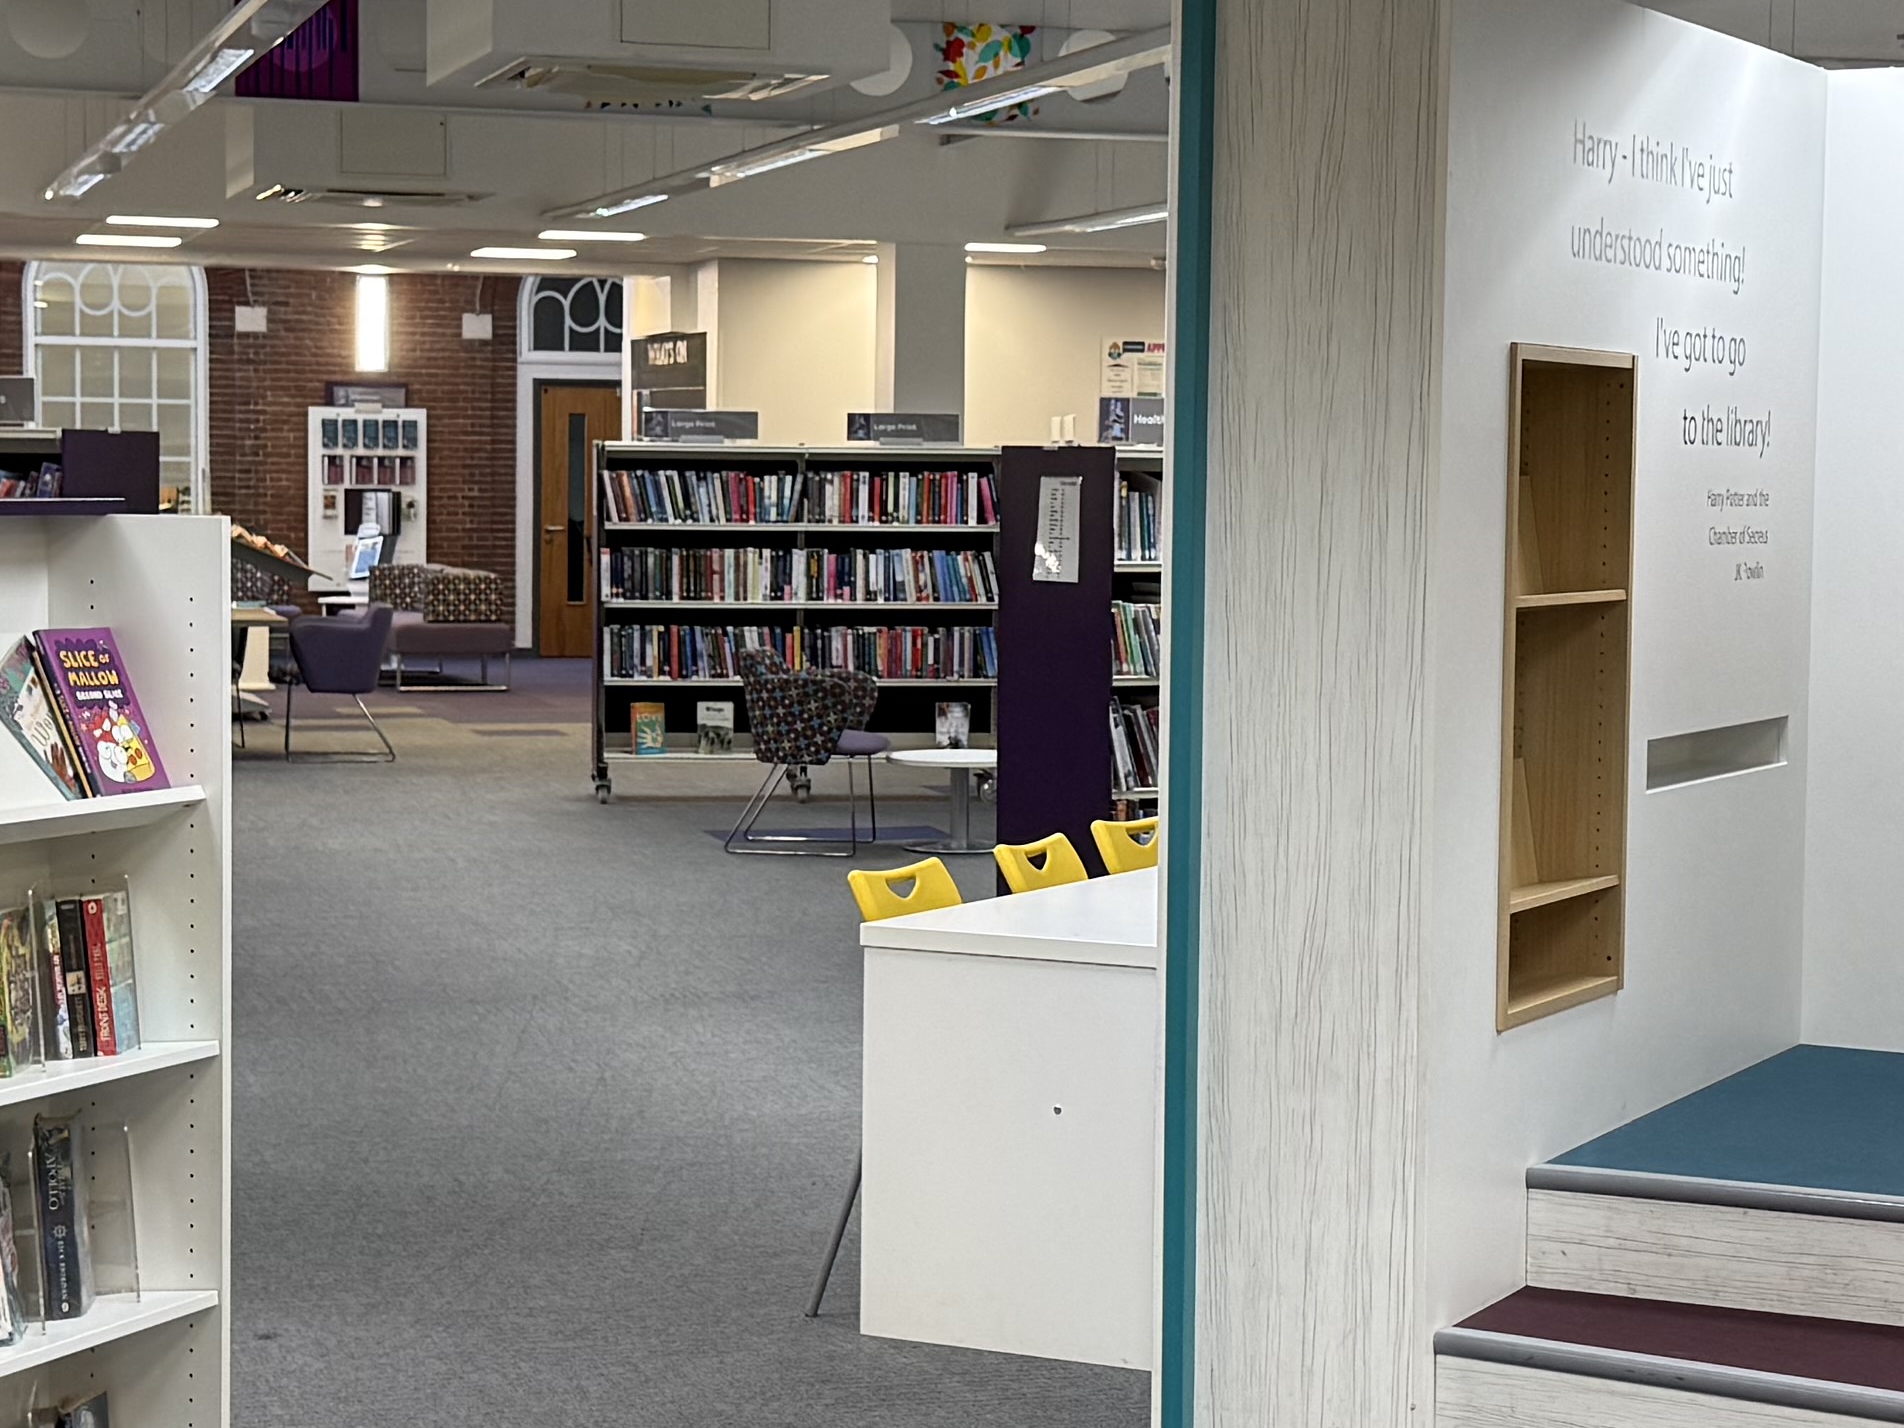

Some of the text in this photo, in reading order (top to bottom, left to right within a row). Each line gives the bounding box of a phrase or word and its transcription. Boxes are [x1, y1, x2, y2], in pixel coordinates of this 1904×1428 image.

[1574, 119, 1618, 185] Harry
[1640, 135, 1677, 186] think
[1682, 147, 1704, 192] I've
[1706, 154, 1733, 204] just
[1572, 217, 1745, 295] understood something!
[1656, 317, 1746, 377] I've got to go
[1683, 404, 1771, 459] to the library!
[59, 651, 98, 669] SLICE
[68, 669, 119, 687] MALLOW
[95, 986, 109, 1040] FRONT DESK
[41, 1152, 61, 1210] APOLLO
